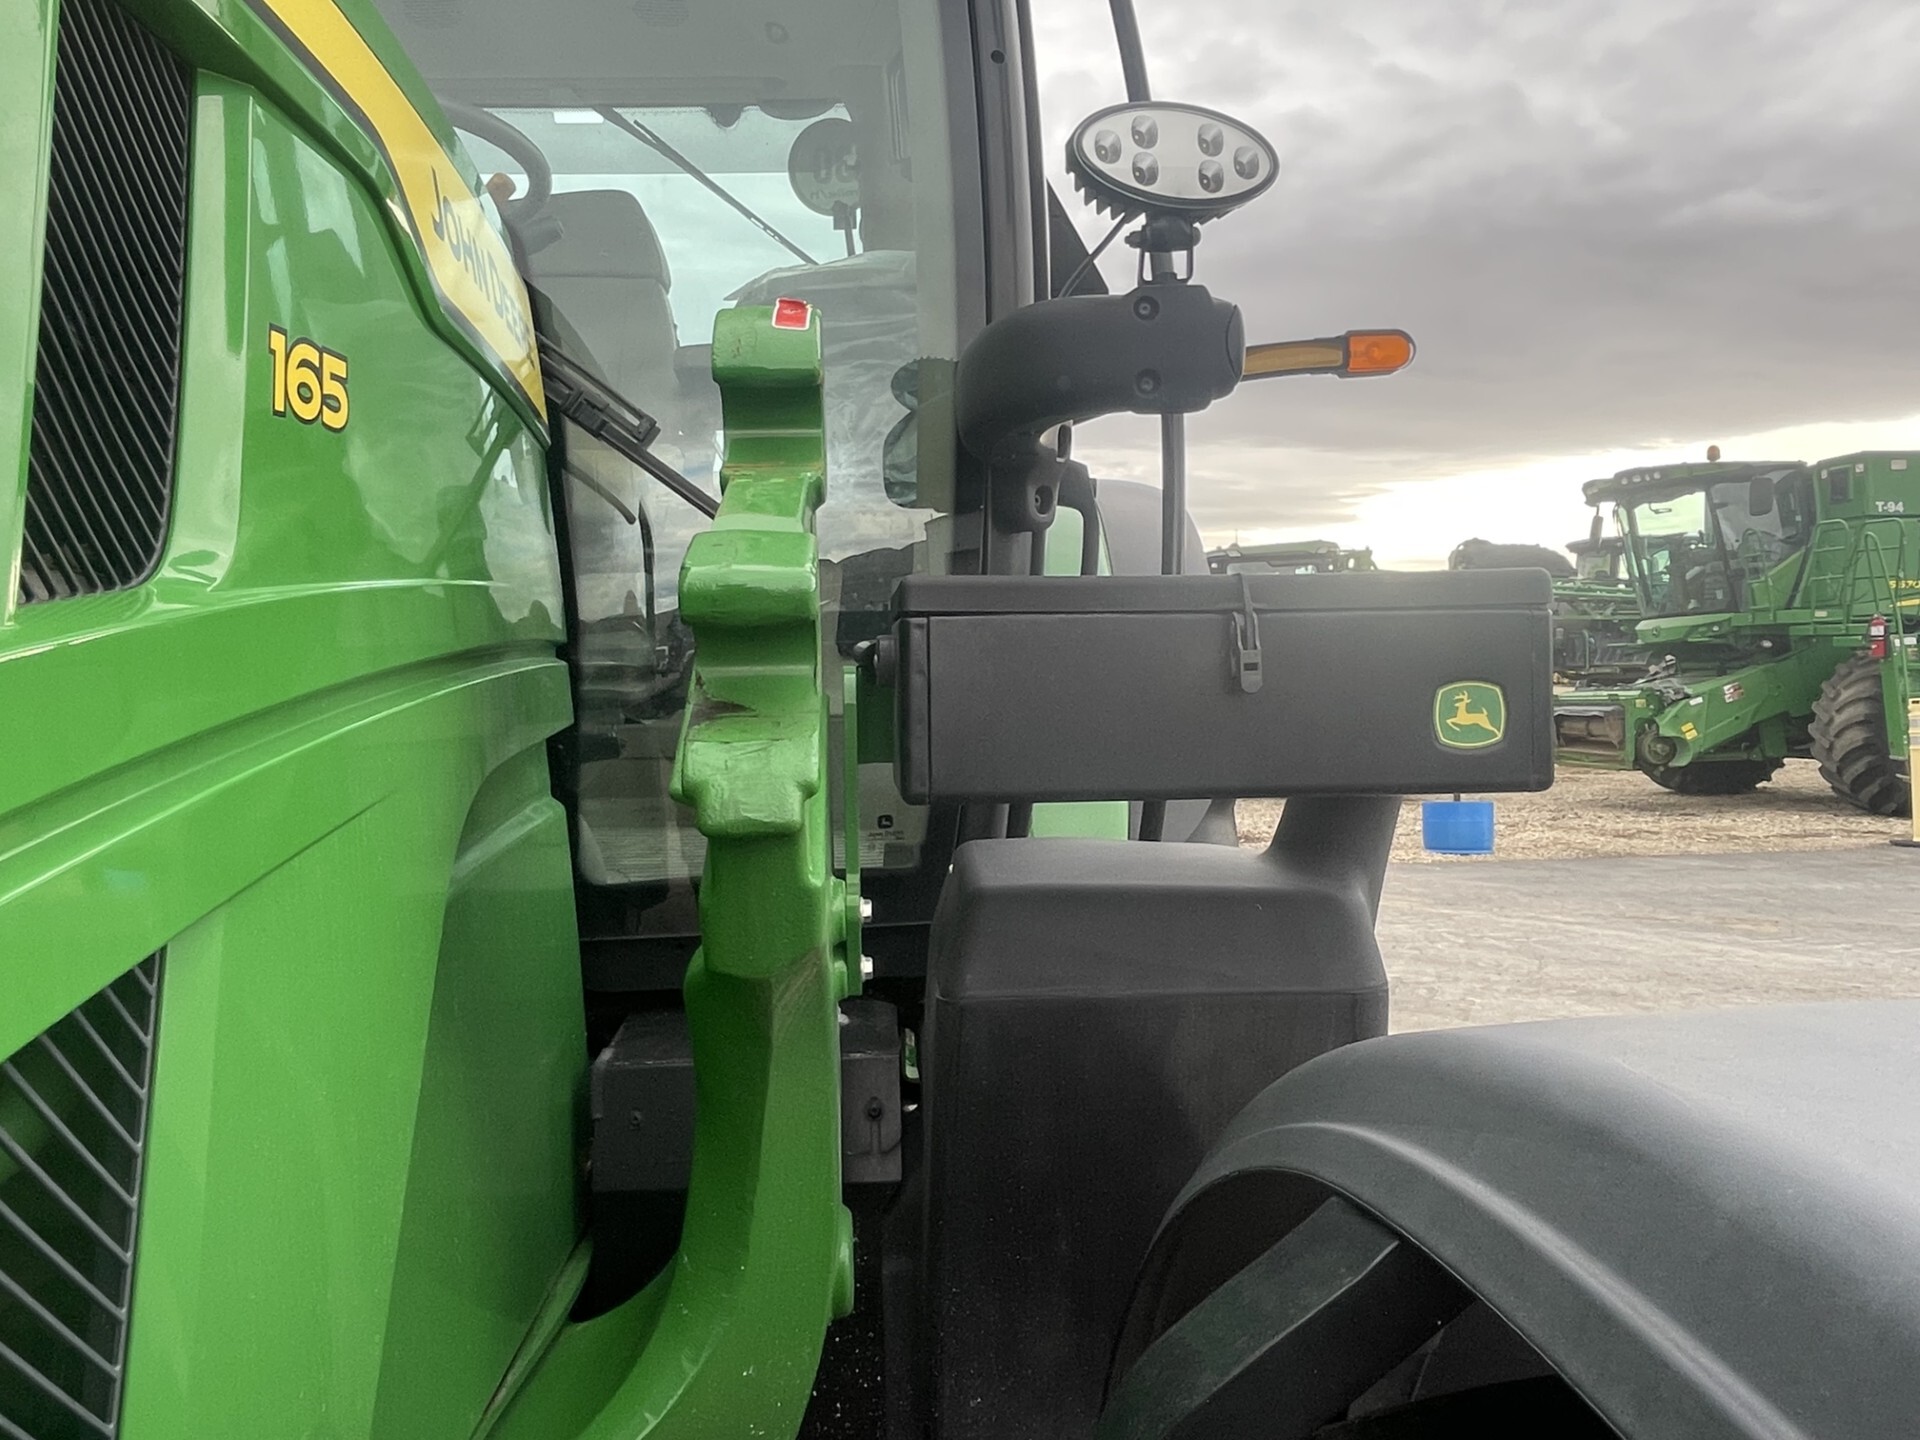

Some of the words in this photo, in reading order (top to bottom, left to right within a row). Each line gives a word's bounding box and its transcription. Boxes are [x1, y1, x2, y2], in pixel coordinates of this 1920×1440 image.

[431, 164, 491, 302] JOHN
[268, 322, 350, 433] 165
[1875, 501, 1904, 512] T-94
